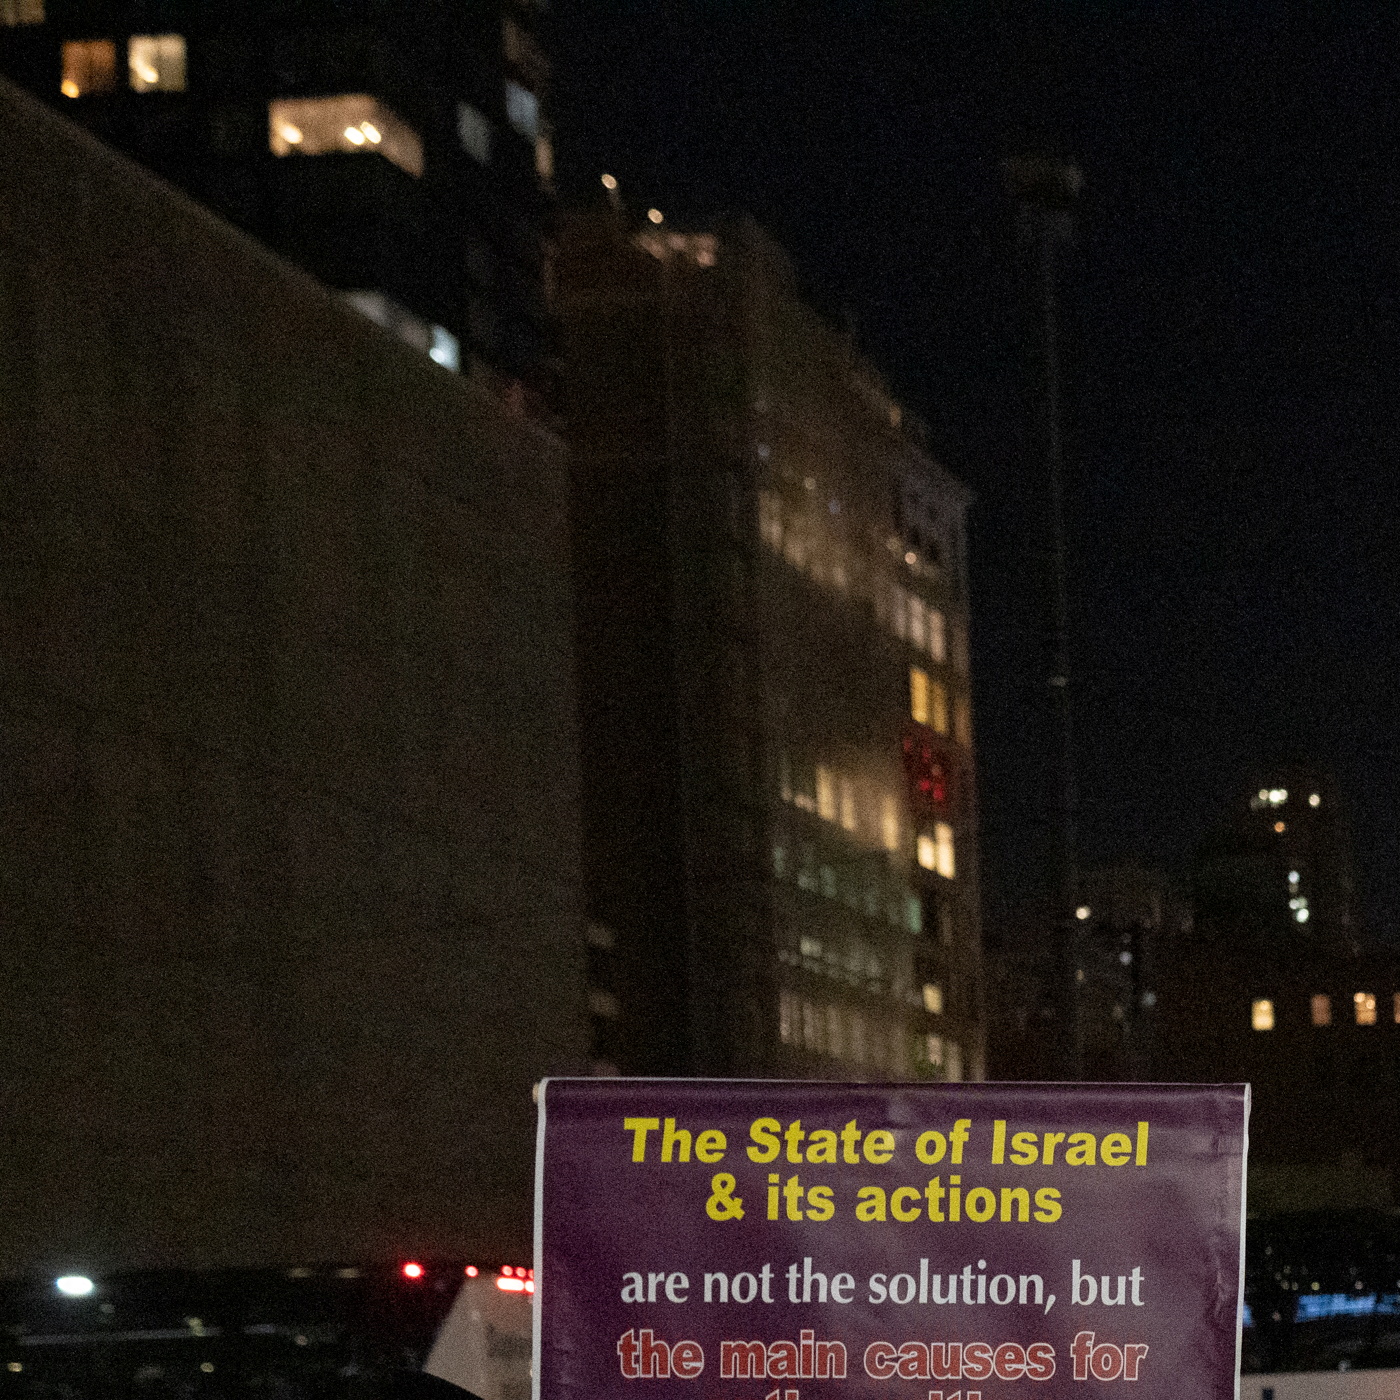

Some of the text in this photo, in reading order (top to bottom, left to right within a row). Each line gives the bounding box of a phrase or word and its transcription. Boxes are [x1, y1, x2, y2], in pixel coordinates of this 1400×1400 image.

[624, 1117, 1151, 1166] The State of Israel
[706, 1172, 1063, 1224] & its actions
[621, 1257, 1144, 1315] are not the solution, but
[618, 1329, 1148, 1381] the main causes for
